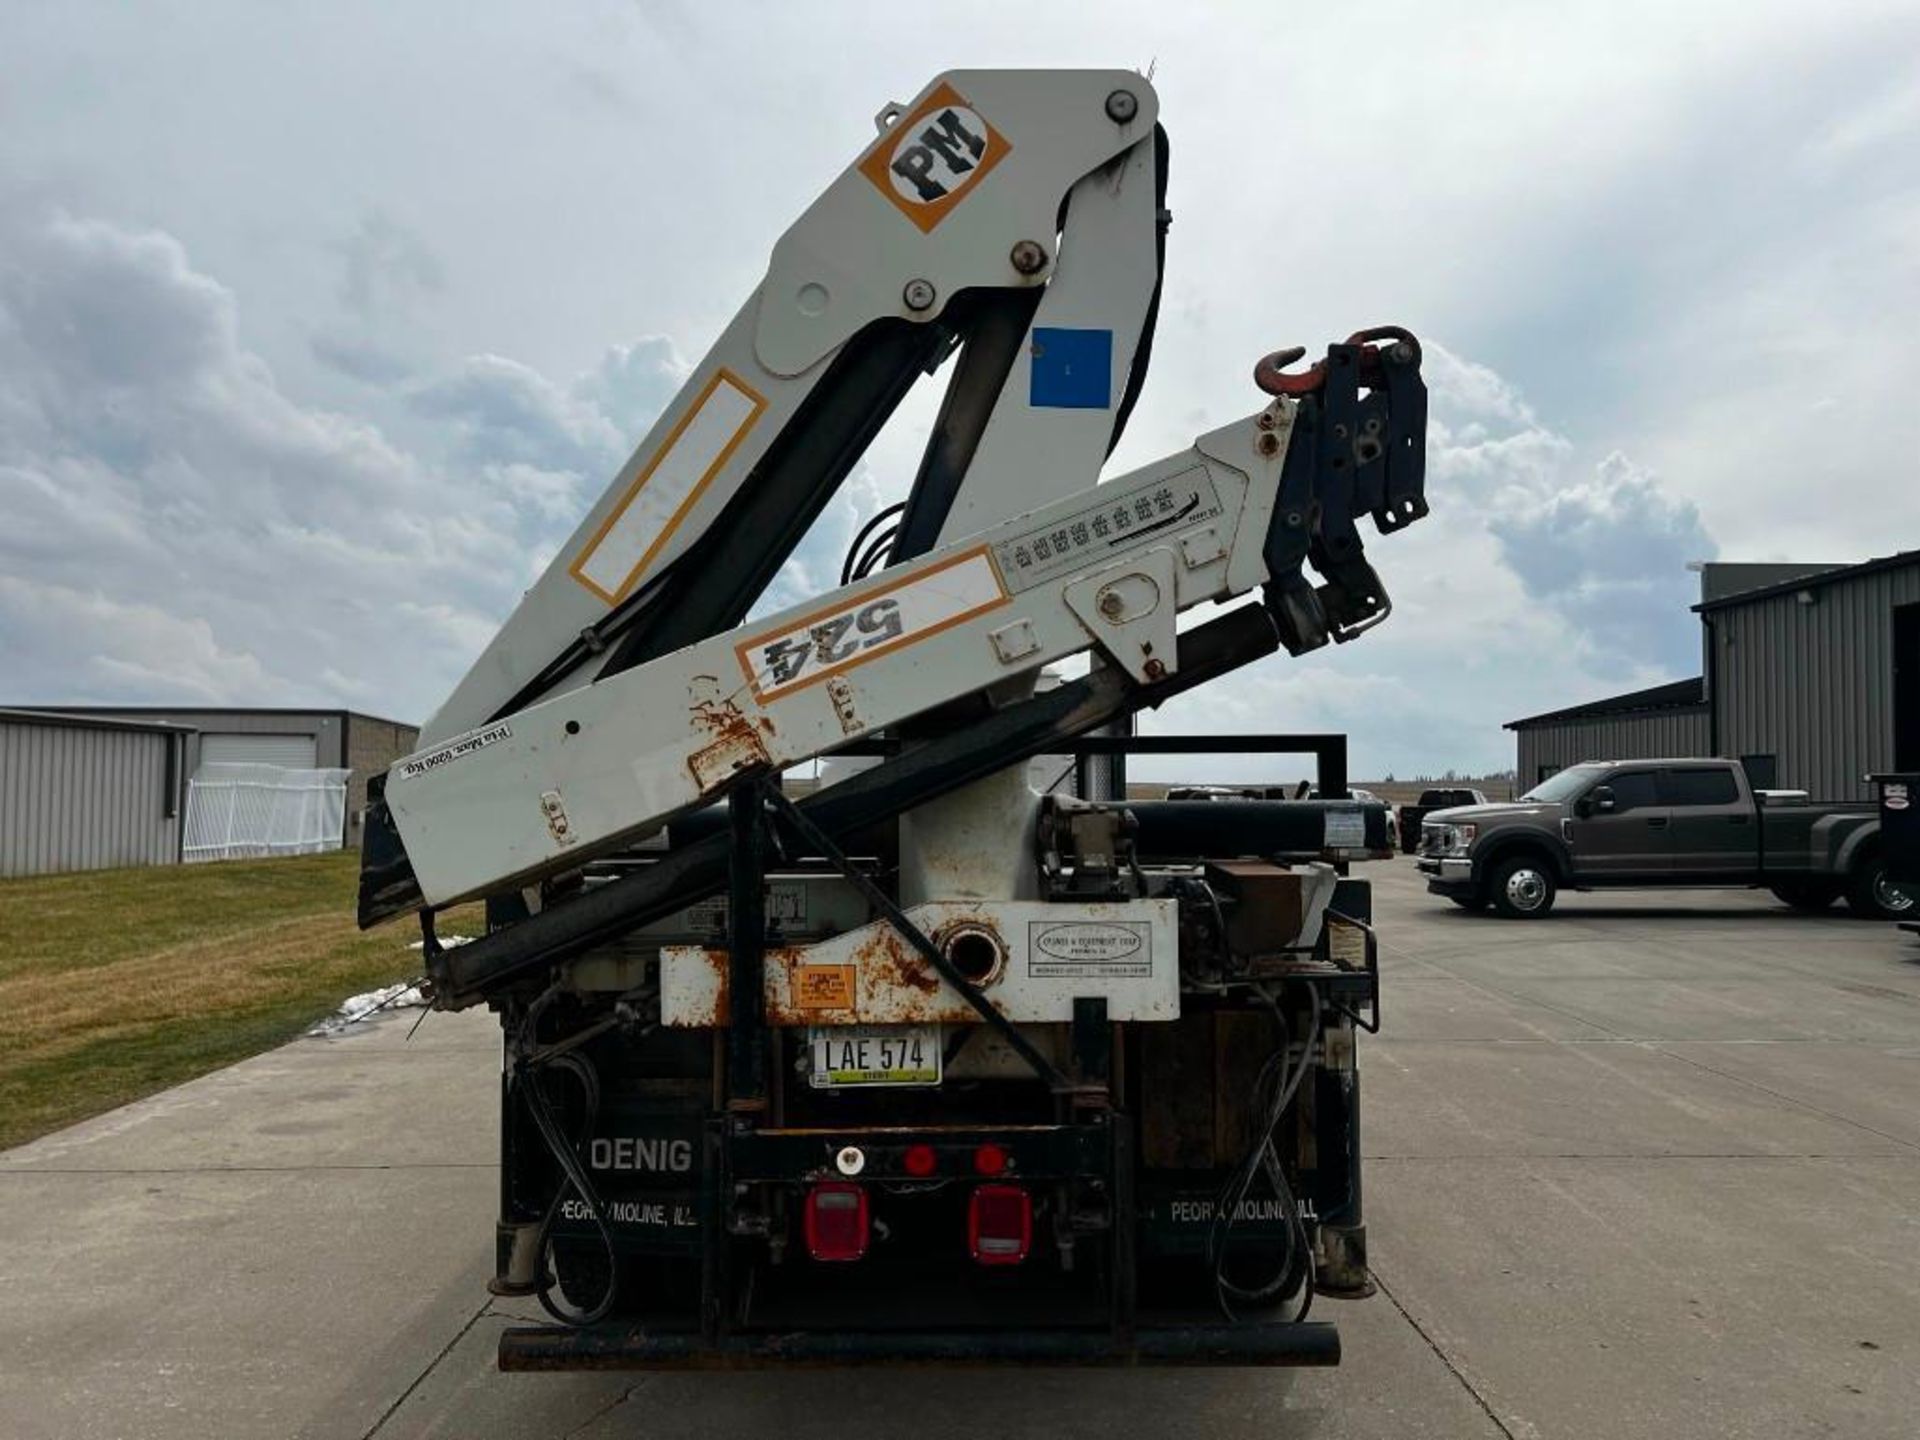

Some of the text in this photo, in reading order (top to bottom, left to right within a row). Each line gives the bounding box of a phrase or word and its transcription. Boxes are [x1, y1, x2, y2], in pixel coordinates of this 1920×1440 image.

[892, 108, 986, 201] PM
[764, 599, 903, 685] 524
[826, 1039, 923, 1070] LAE 574
[576, 1137, 692, 1171] OENIG
